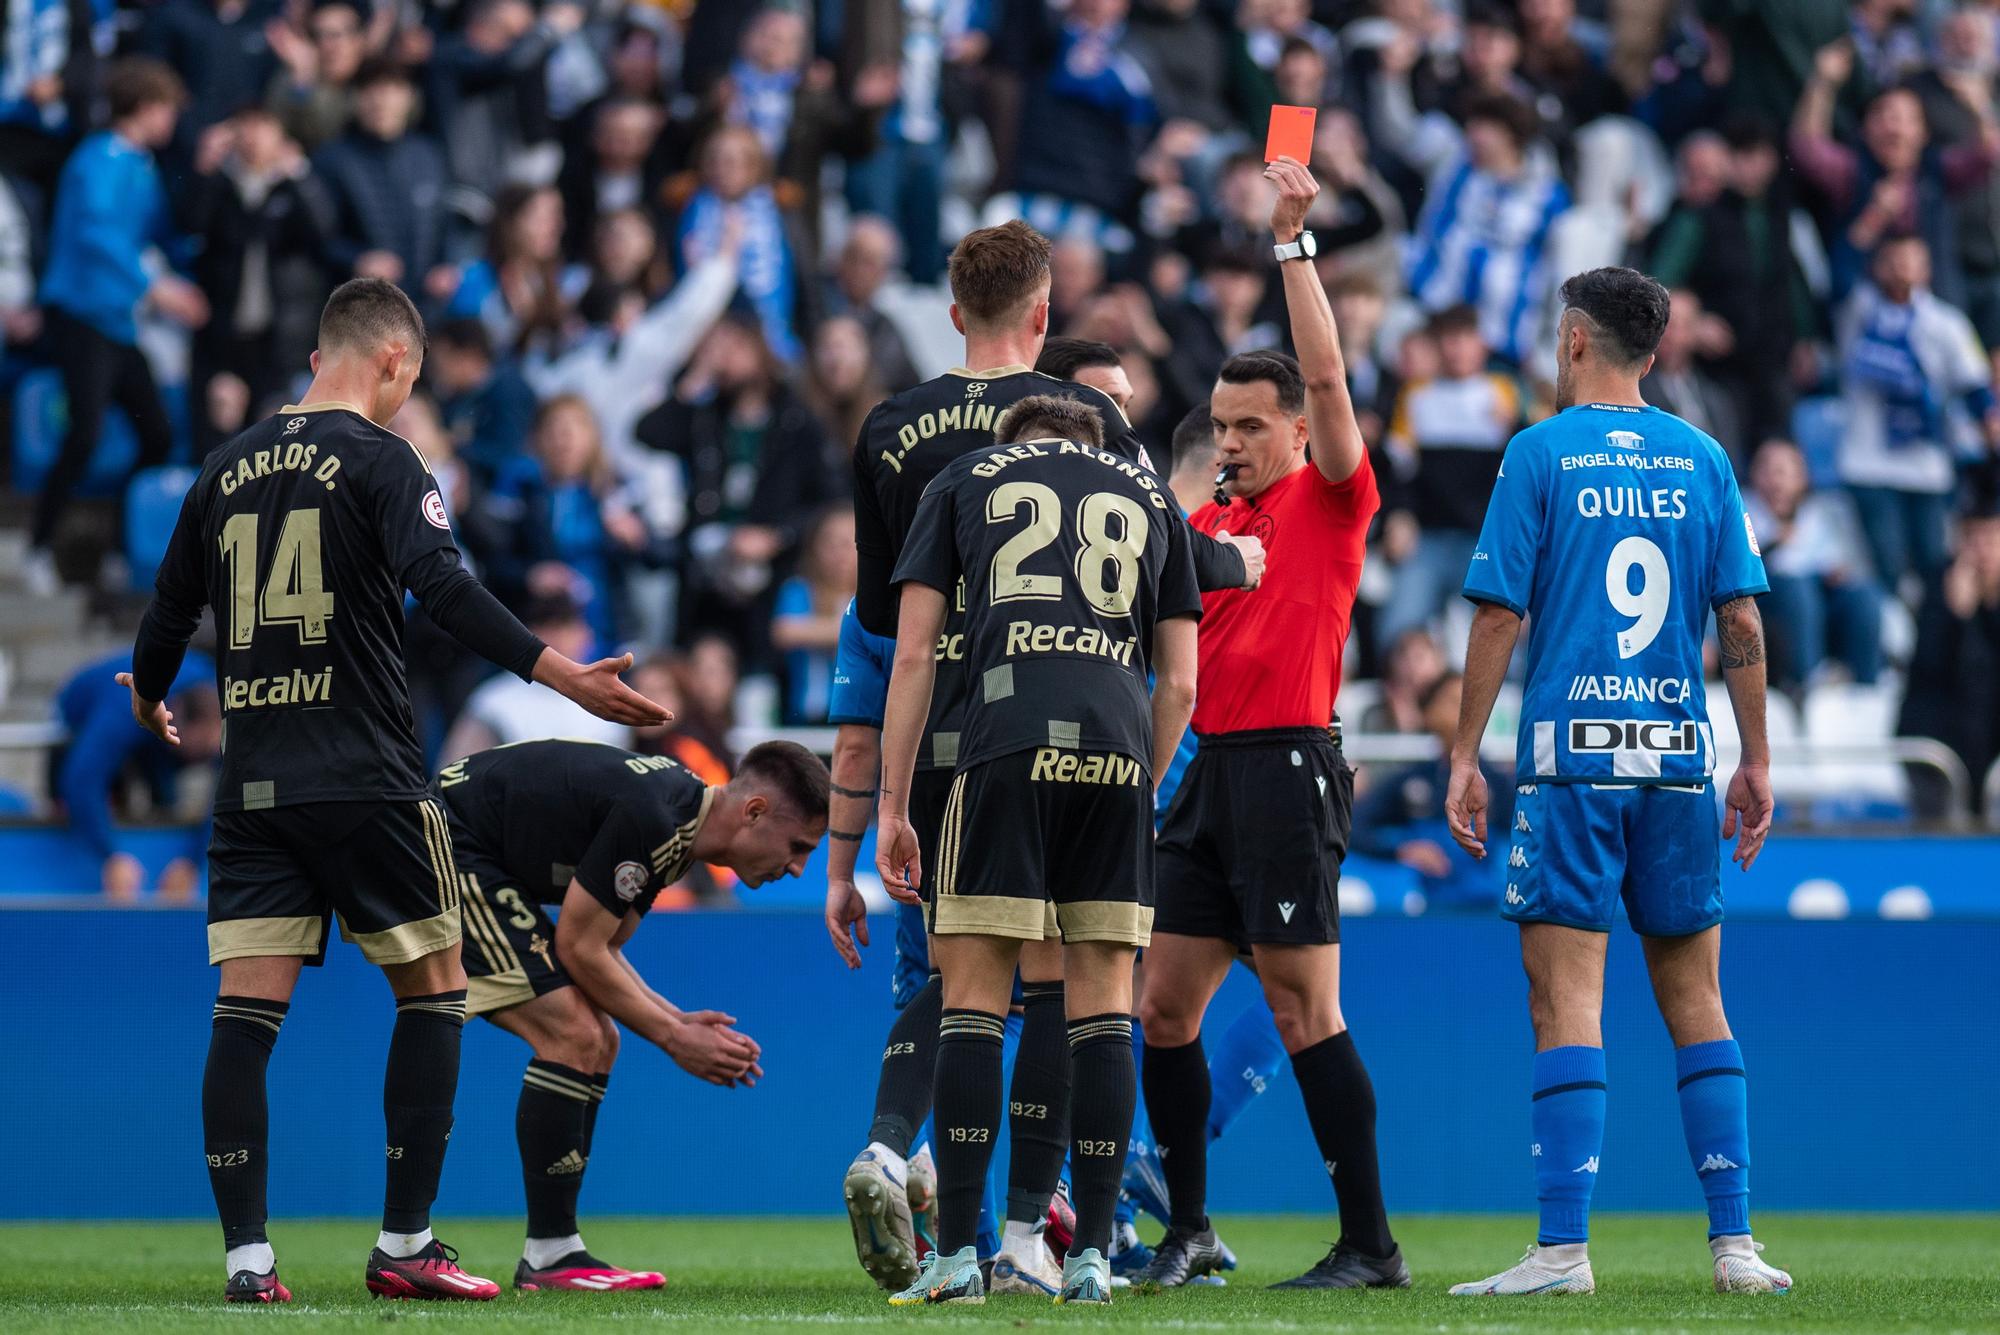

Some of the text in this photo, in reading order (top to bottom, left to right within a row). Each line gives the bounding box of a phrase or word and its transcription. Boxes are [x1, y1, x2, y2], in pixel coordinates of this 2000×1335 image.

[220, 442, 341, 496] CARLOS D.
[972, 441, 1167, 509] GAEL ALONSO
[1577, 486, 1687, 520] QUILES
[986, 482, 1149, 618] 28
[217, 507, 334, 650] 14
[1605, 536, 1671, 660] 9
[1006, 621, 1136, 667] Recalvi
[223, 666, 333, 711] Recalvi
[1572, 722, 1696, 751] DIGI
[495, 887, 536, 930] 3
[883, 1042, 915, 1059] 923
[1010, 1101, 1047, 1119] 1923
[948, 1128, 989, 1142] 1923
[1078, 1140, 1116, 1156] 1923
[206, 1150, 248, 1167] 1923
